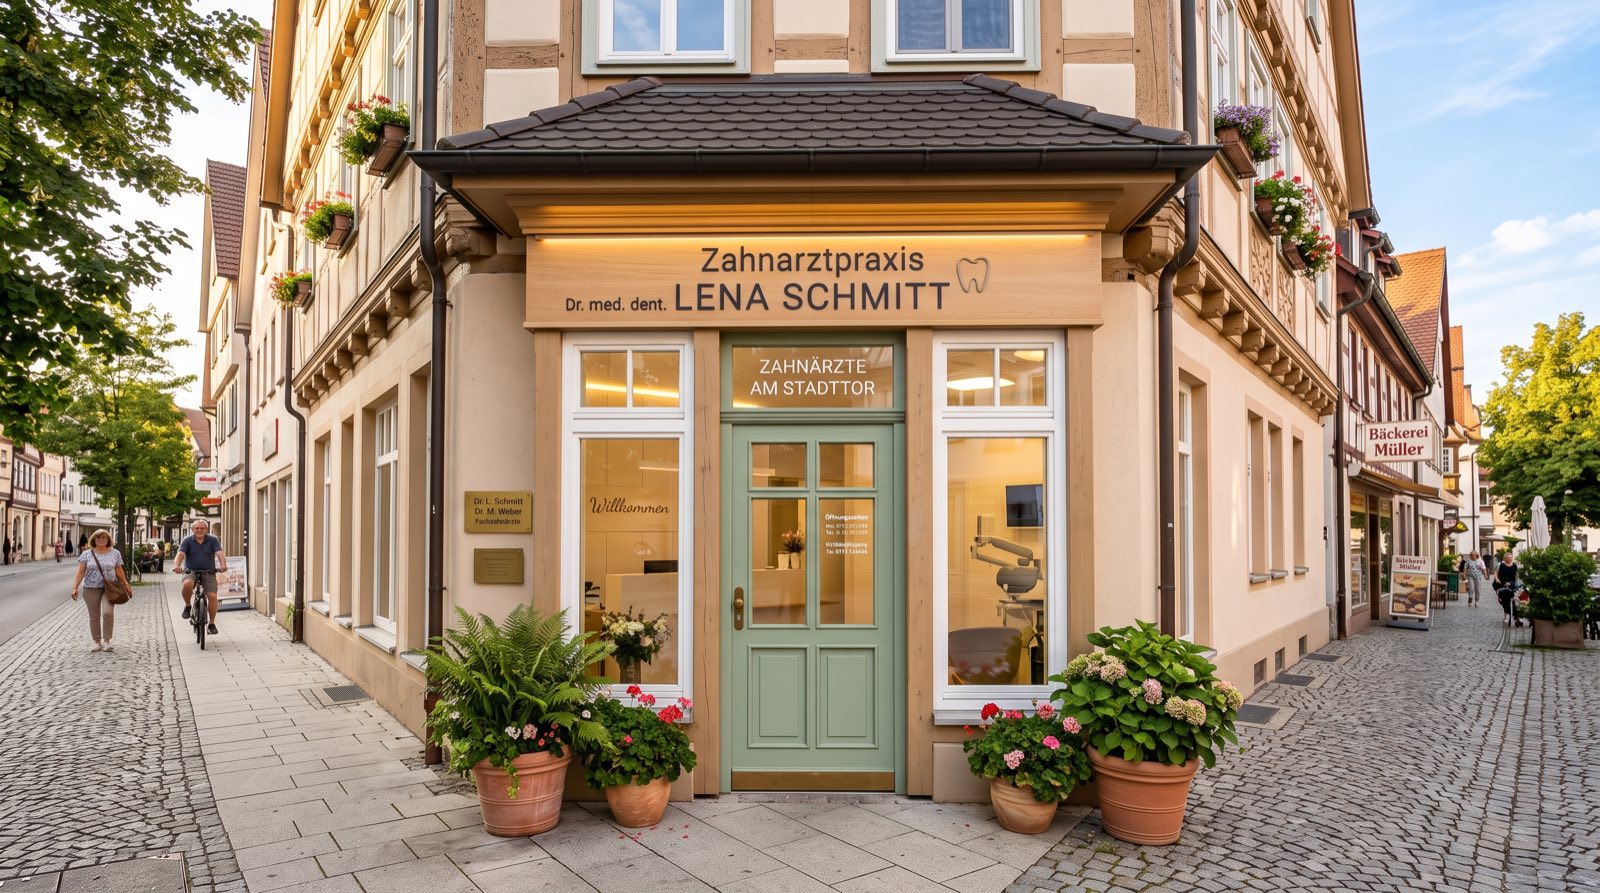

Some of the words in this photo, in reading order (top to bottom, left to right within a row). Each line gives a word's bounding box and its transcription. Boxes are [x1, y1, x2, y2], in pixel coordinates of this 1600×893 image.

[701, 246, 924, 278] Zahnarztpraxis
[565, 297, 584, 311] Dr.
[589, 297, 625, 311] med.
[630, 297, 667, 311] dent.
[675, 283, 769, 311] LENA
[783, 282, 950, 310] SCHMITT
[760, 356, 866, 374] ZAHNÄRZTE
[750, 380, 778, 396] AM
[783, 380, 875, 396] STADTTOR
[1369, 425, 1429, 440] Bäckerei
[1375, 442, 1424, 457] Müller
[473, 497, 484, 505] Dr.
[494, 497, 523, 505] Schmitt
[589, 496, 670, 514] Willkommen
[498, 507, 522, 515] Weber
